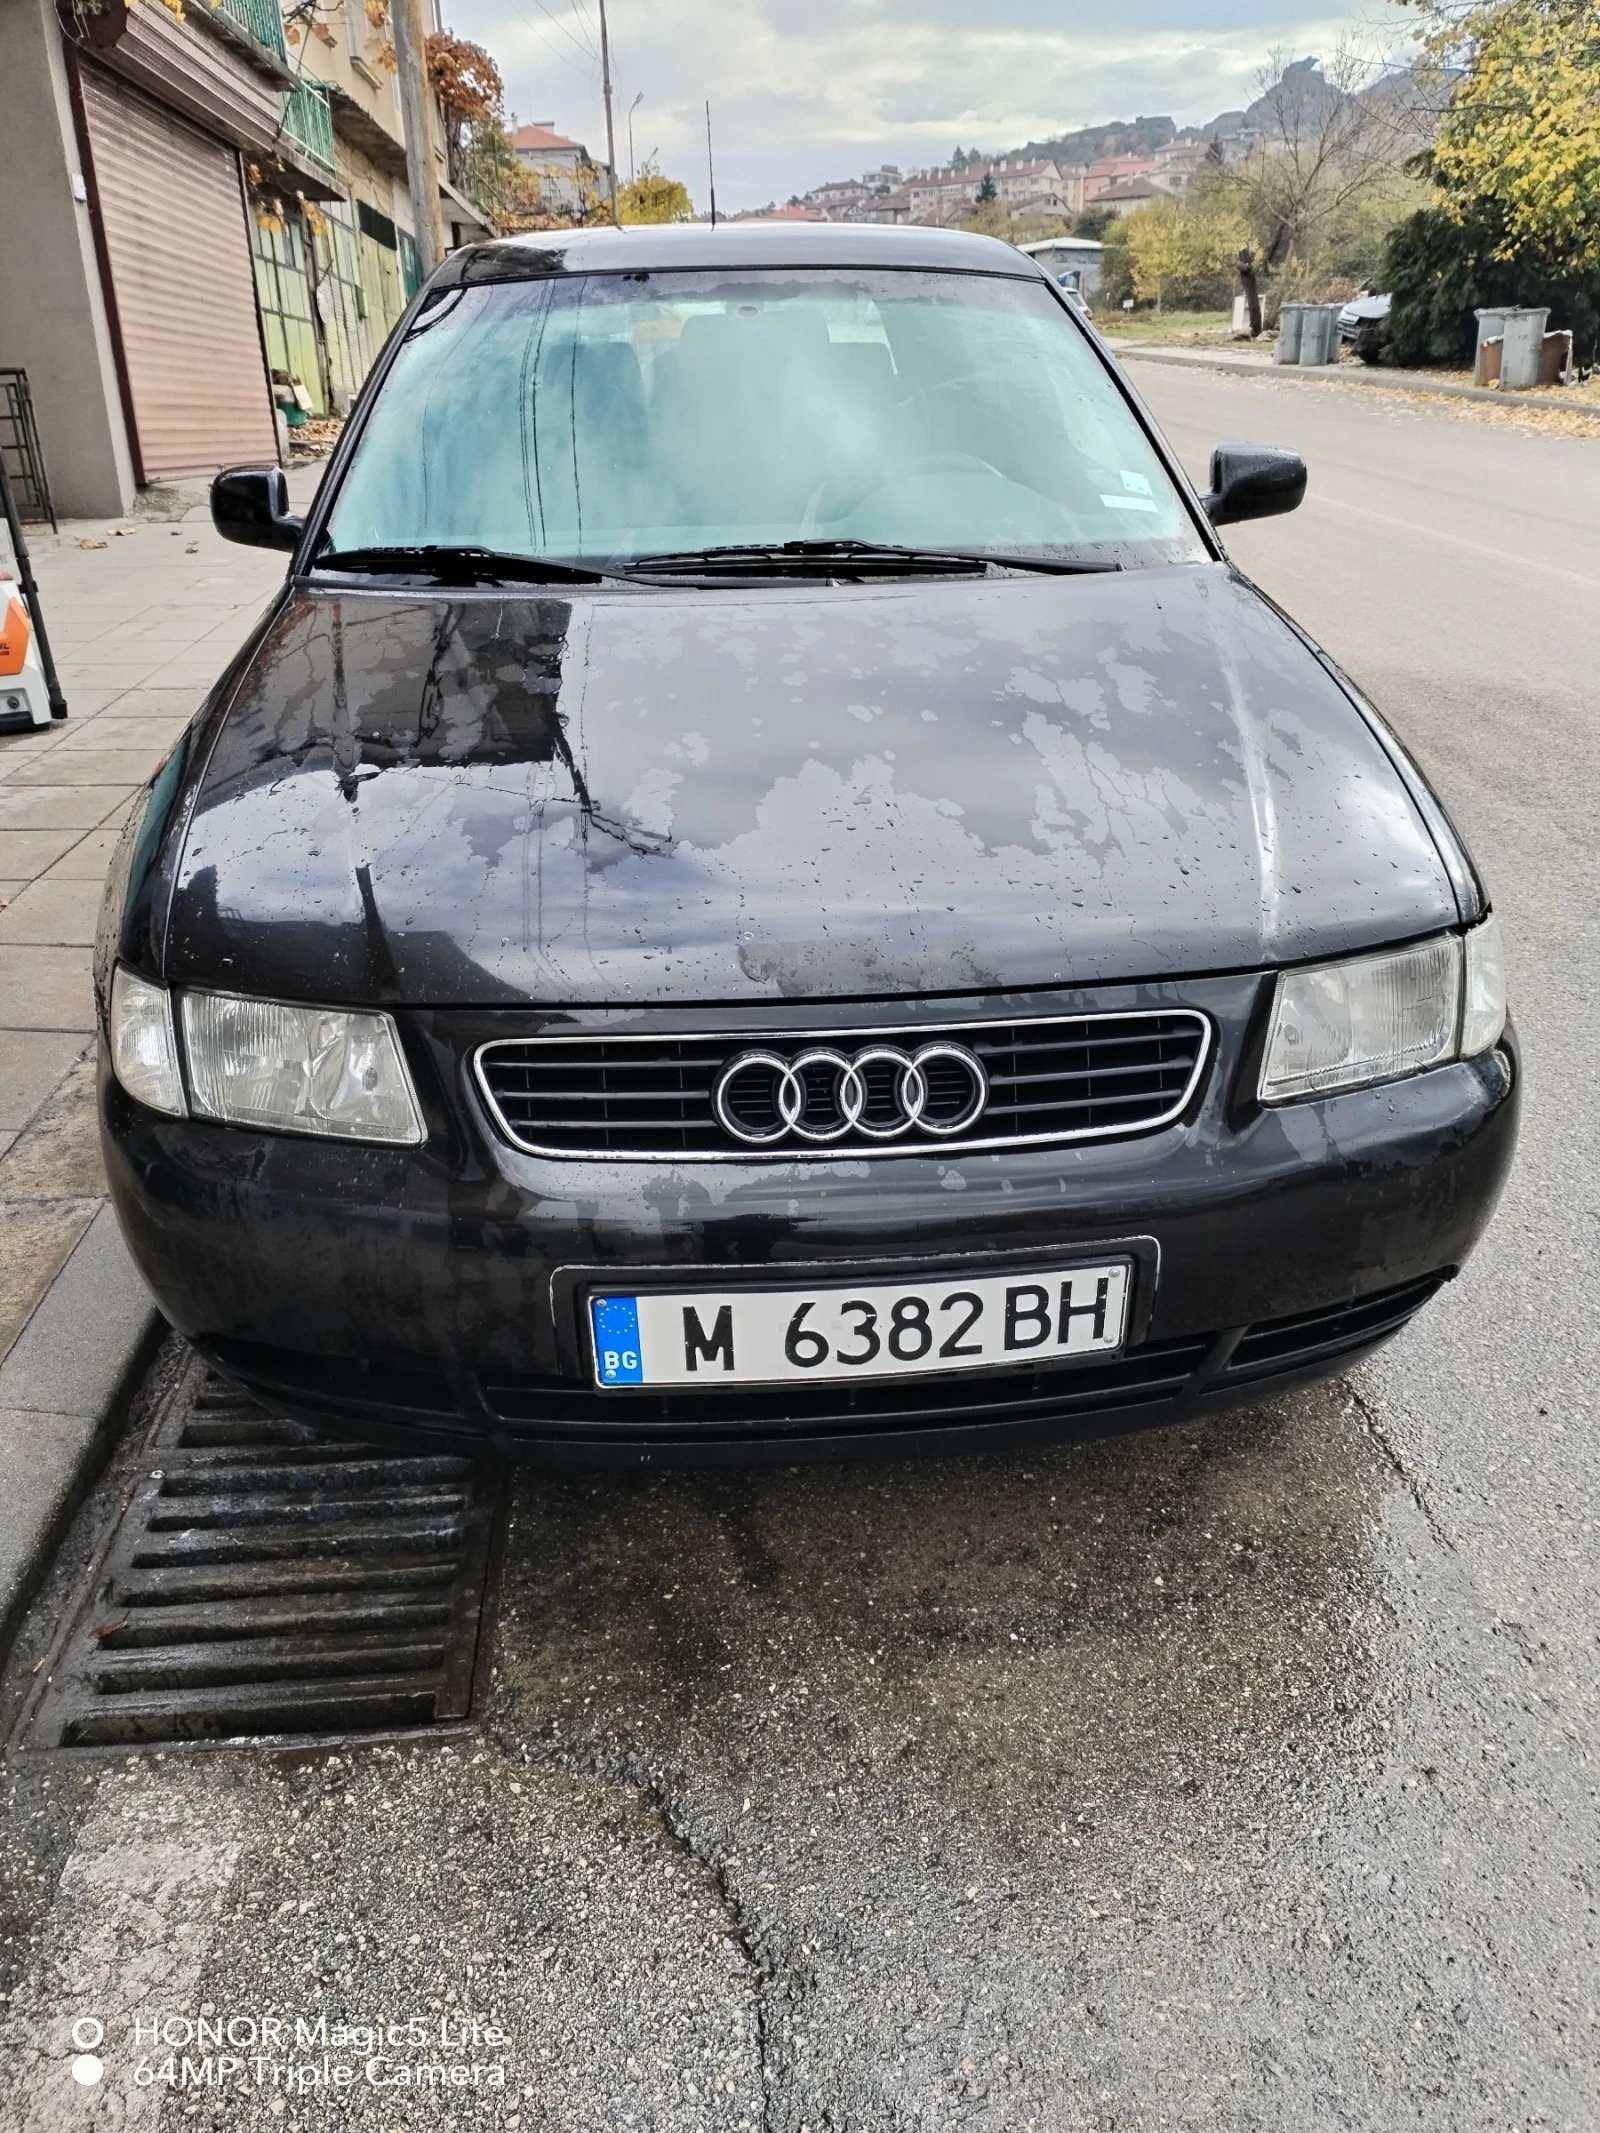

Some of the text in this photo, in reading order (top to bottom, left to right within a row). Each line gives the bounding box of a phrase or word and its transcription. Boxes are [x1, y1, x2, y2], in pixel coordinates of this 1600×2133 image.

[683, 1277, 1109, 1371] M 6382 BH
[604, 1350, 638, 1370] BG
